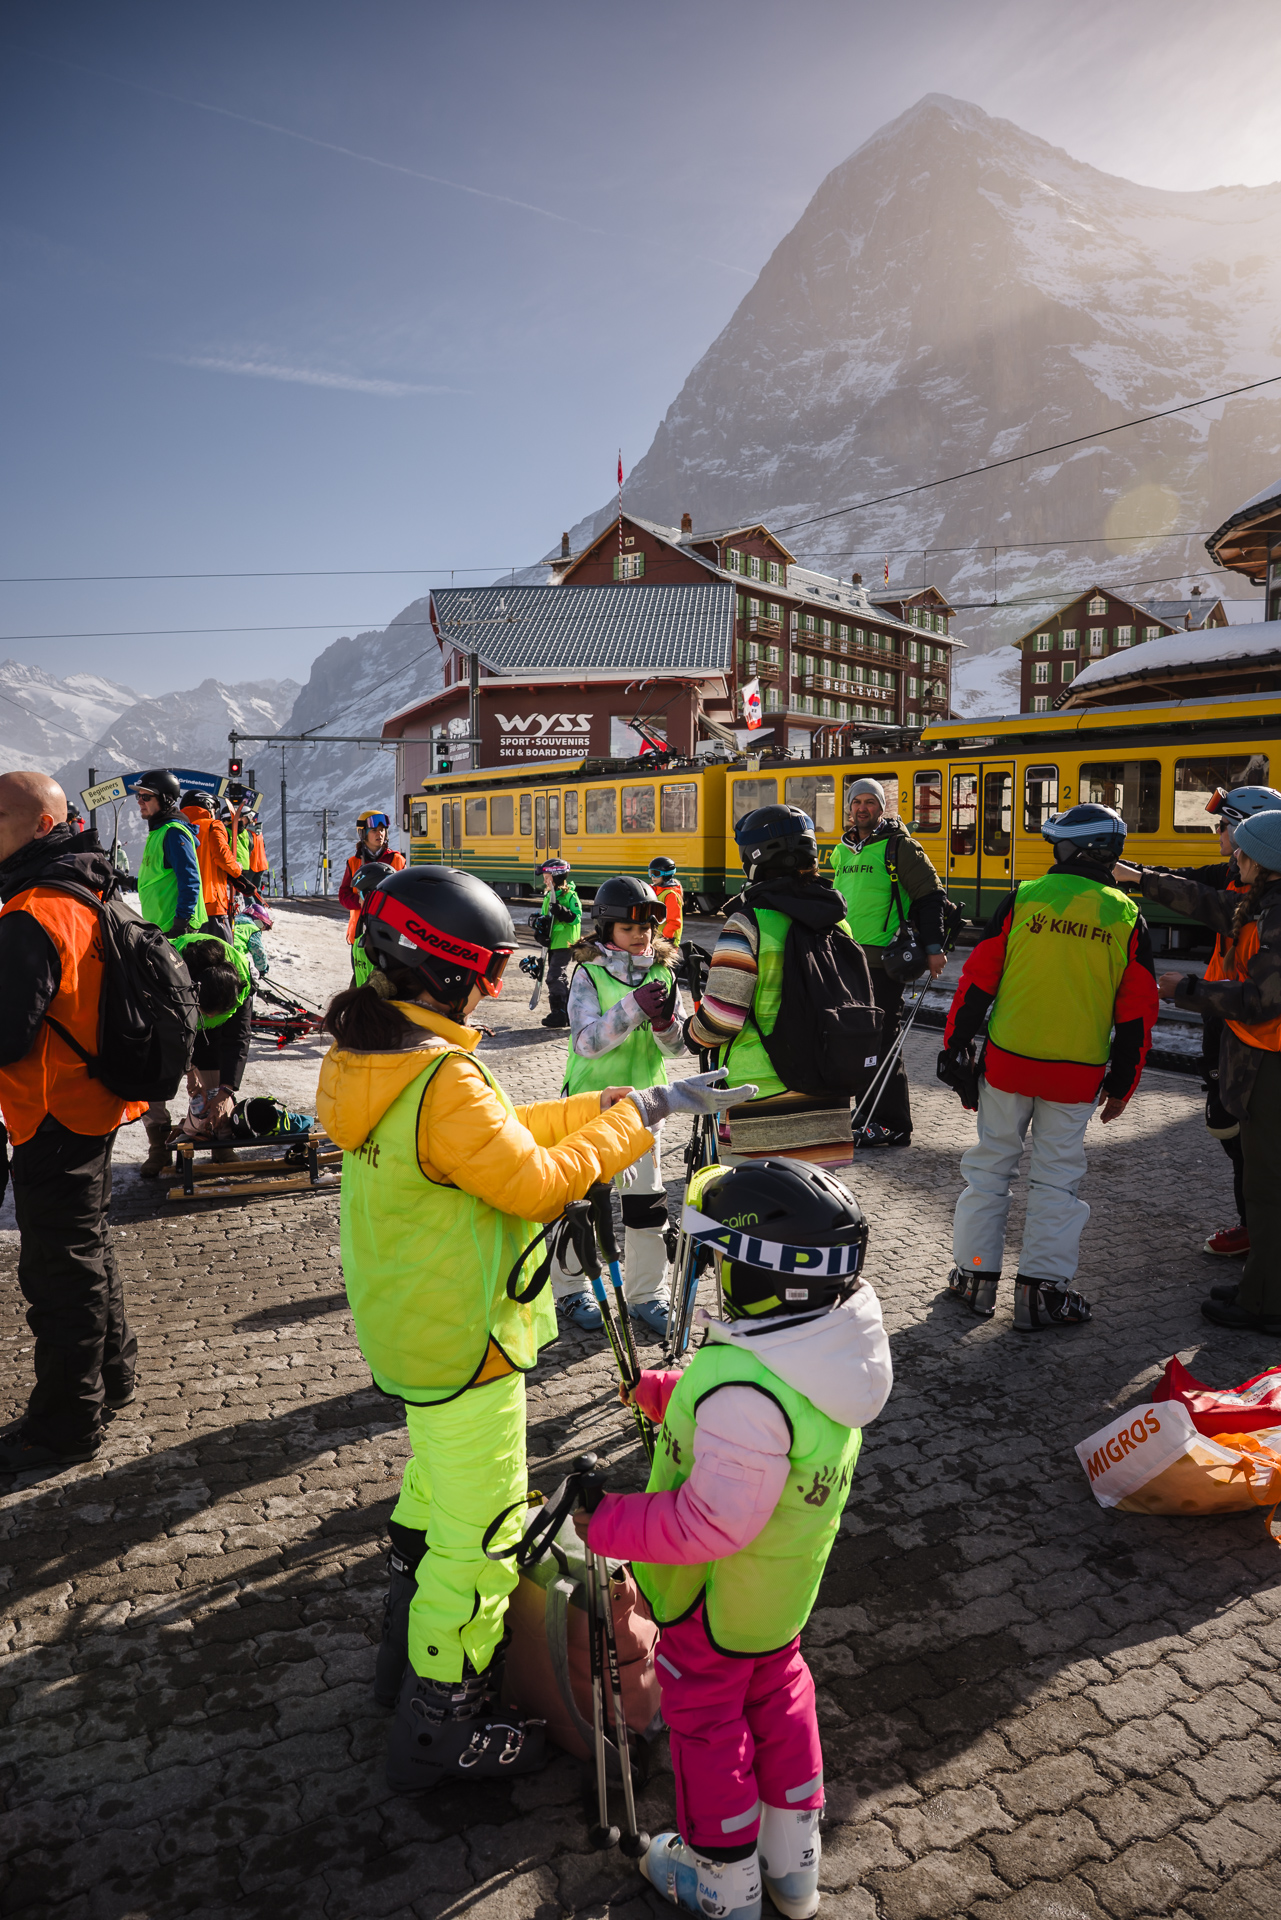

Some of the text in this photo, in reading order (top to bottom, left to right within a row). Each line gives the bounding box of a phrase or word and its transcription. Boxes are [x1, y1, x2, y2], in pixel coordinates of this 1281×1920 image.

[823, 679, 886, 699] BELLEVUE
[500, 738, 590, 746] SPORT SOUVENIRS
[88, 782, 119, 798] Beginners
[178, 778, 214, 788] Grindelwald
[901, 791, 908, 804] 2
[1063, 786, 1072, 800] 2
[92, 796, 106, 805] Park
[842, 864, 874, 874] KiKli Fit
[1050, 918, 1113, 946] KiKli Fit
[405, 920, 480, 964] CARRERA
[1086, 1408, 1161, 1482] MIGROS
[410, 1756, 444, 1768] TECNICA
[700, 1882, 718, 1900] GAIA
